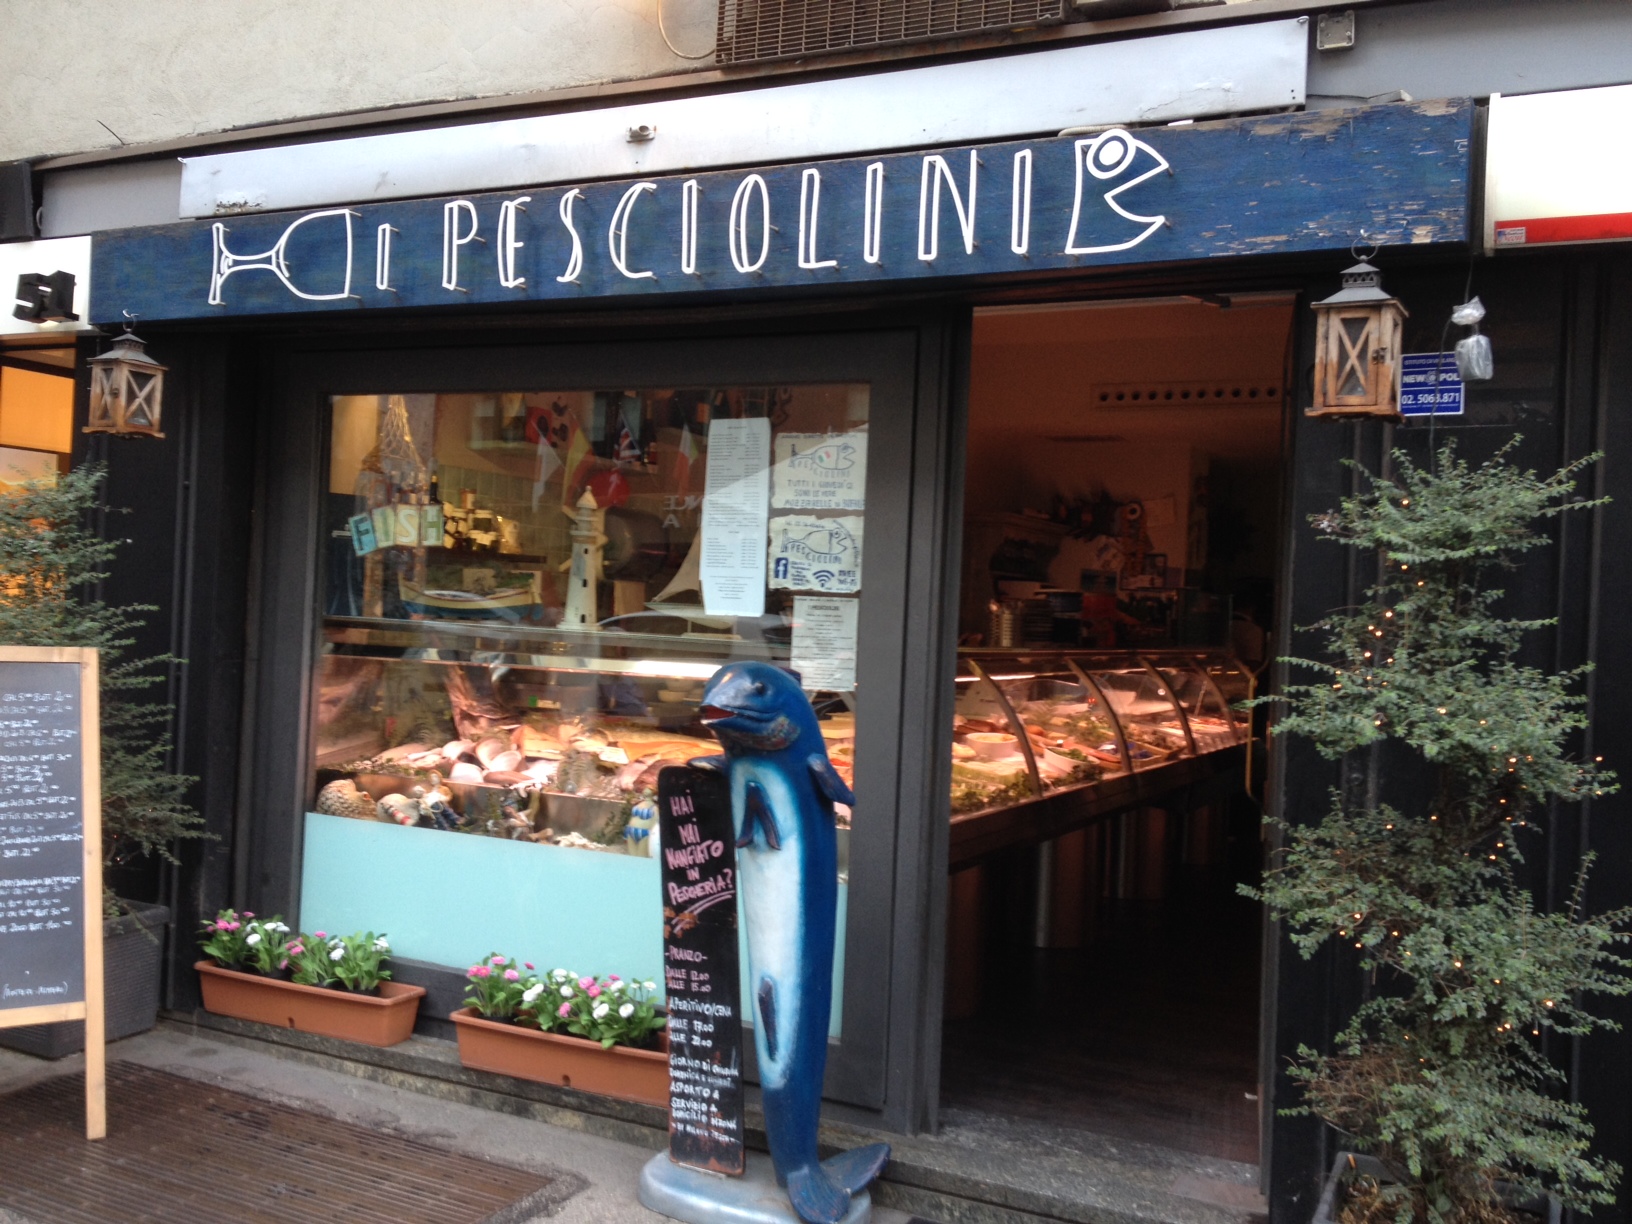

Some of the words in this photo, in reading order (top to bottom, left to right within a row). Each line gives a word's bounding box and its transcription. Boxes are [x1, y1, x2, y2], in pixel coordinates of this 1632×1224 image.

[376, 223, 391, 290] I
[441, 148, 1032, 291] PESCIOLINI
[1403, 374, 1425, 382] NEW
[1439, 373, 1460, 381] POL
[350, 505, 444, 554] FISH
